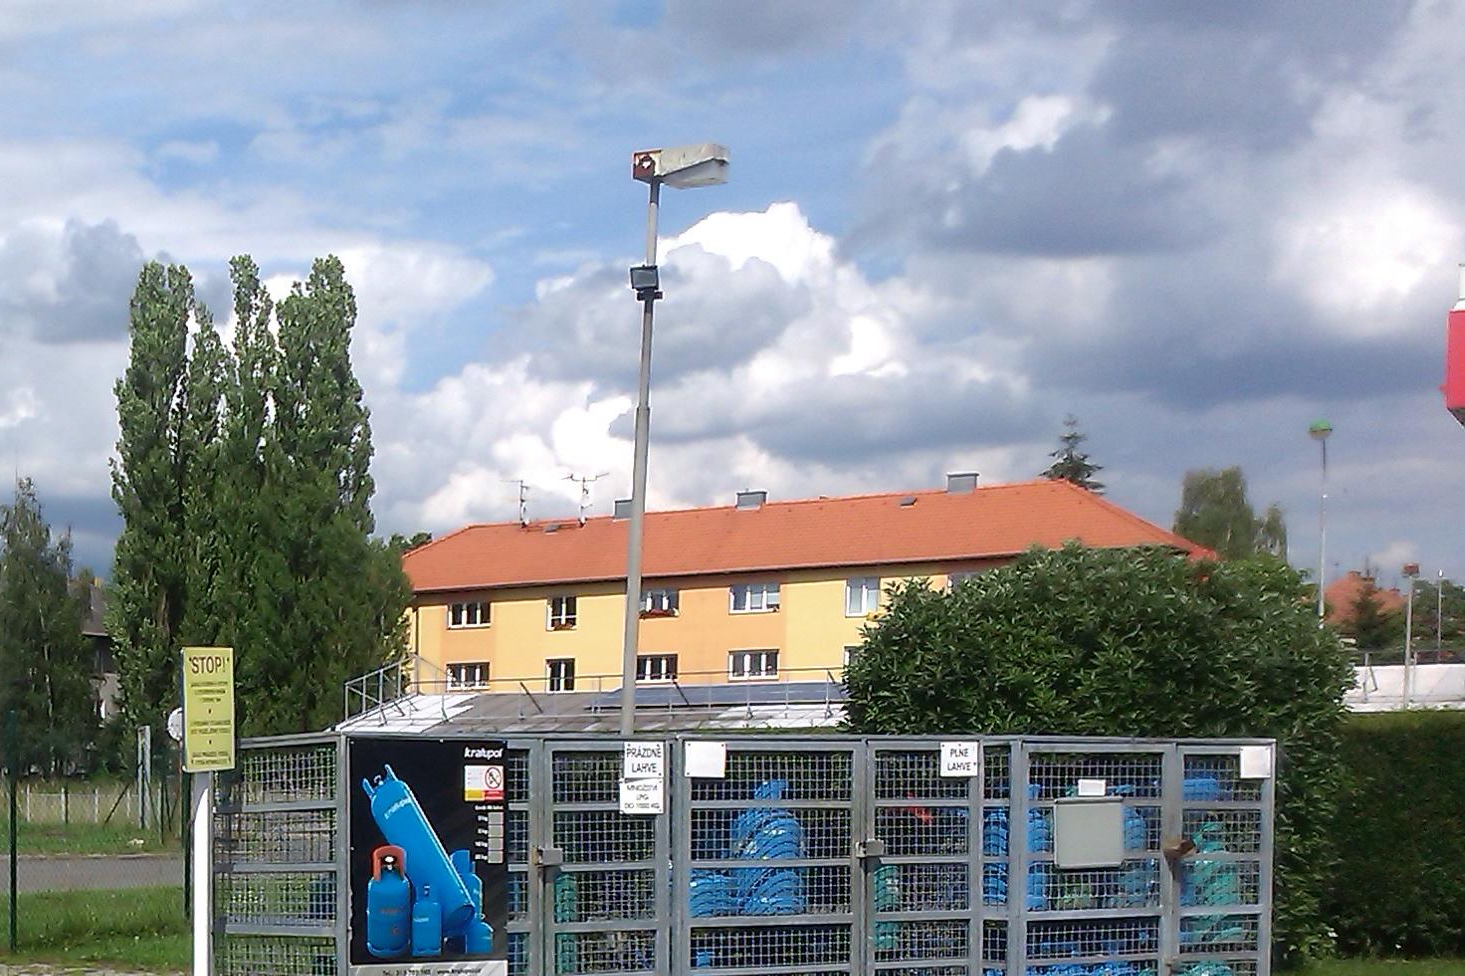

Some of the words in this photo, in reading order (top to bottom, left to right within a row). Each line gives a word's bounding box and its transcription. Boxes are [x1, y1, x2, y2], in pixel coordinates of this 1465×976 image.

[464, 747, 503, 760] kralupol
[631, 763, 657, 773] LAHVE
[947, 762, 972, 771] LAHVE
